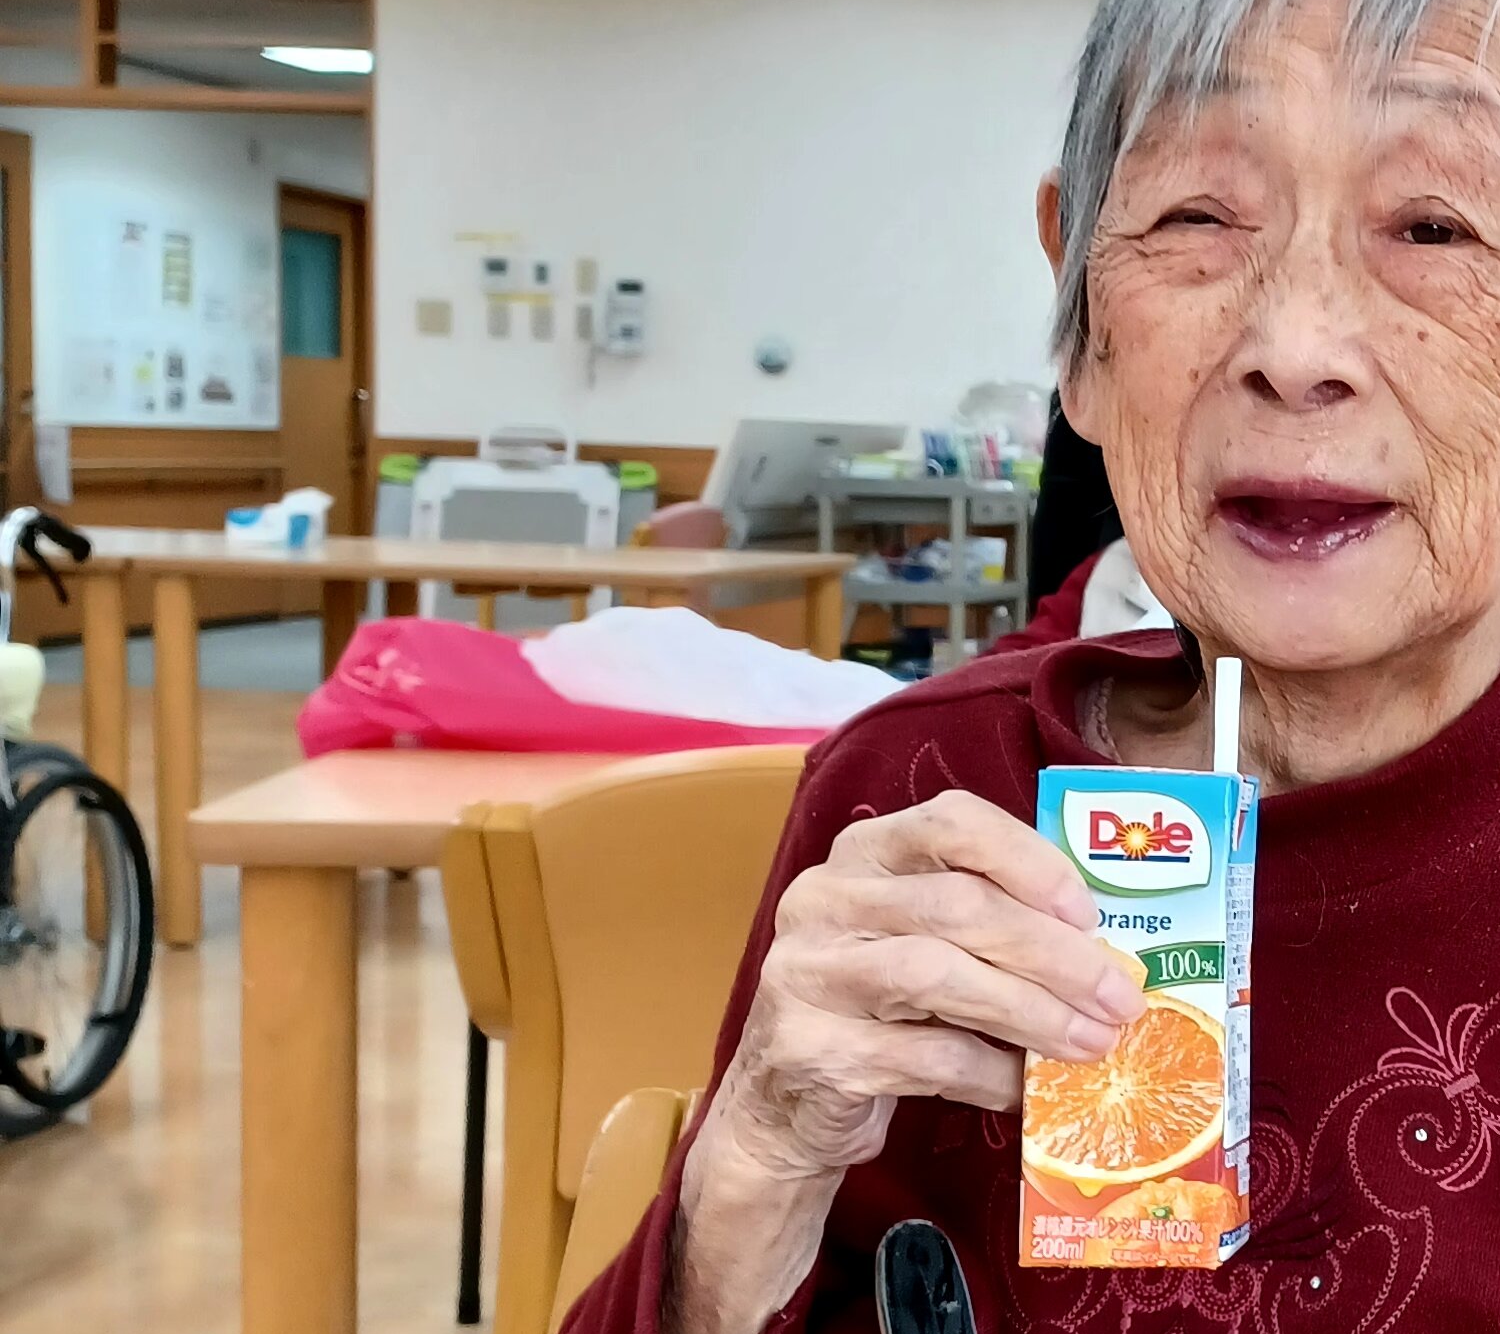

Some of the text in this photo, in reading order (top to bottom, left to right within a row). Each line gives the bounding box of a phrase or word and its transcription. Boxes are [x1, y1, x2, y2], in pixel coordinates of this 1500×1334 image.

[1089, 810, 1193, 856] Dole
[1156, 948, 1217, 981] 100%
[1030, 1238, 1085, 1260] 200ml
